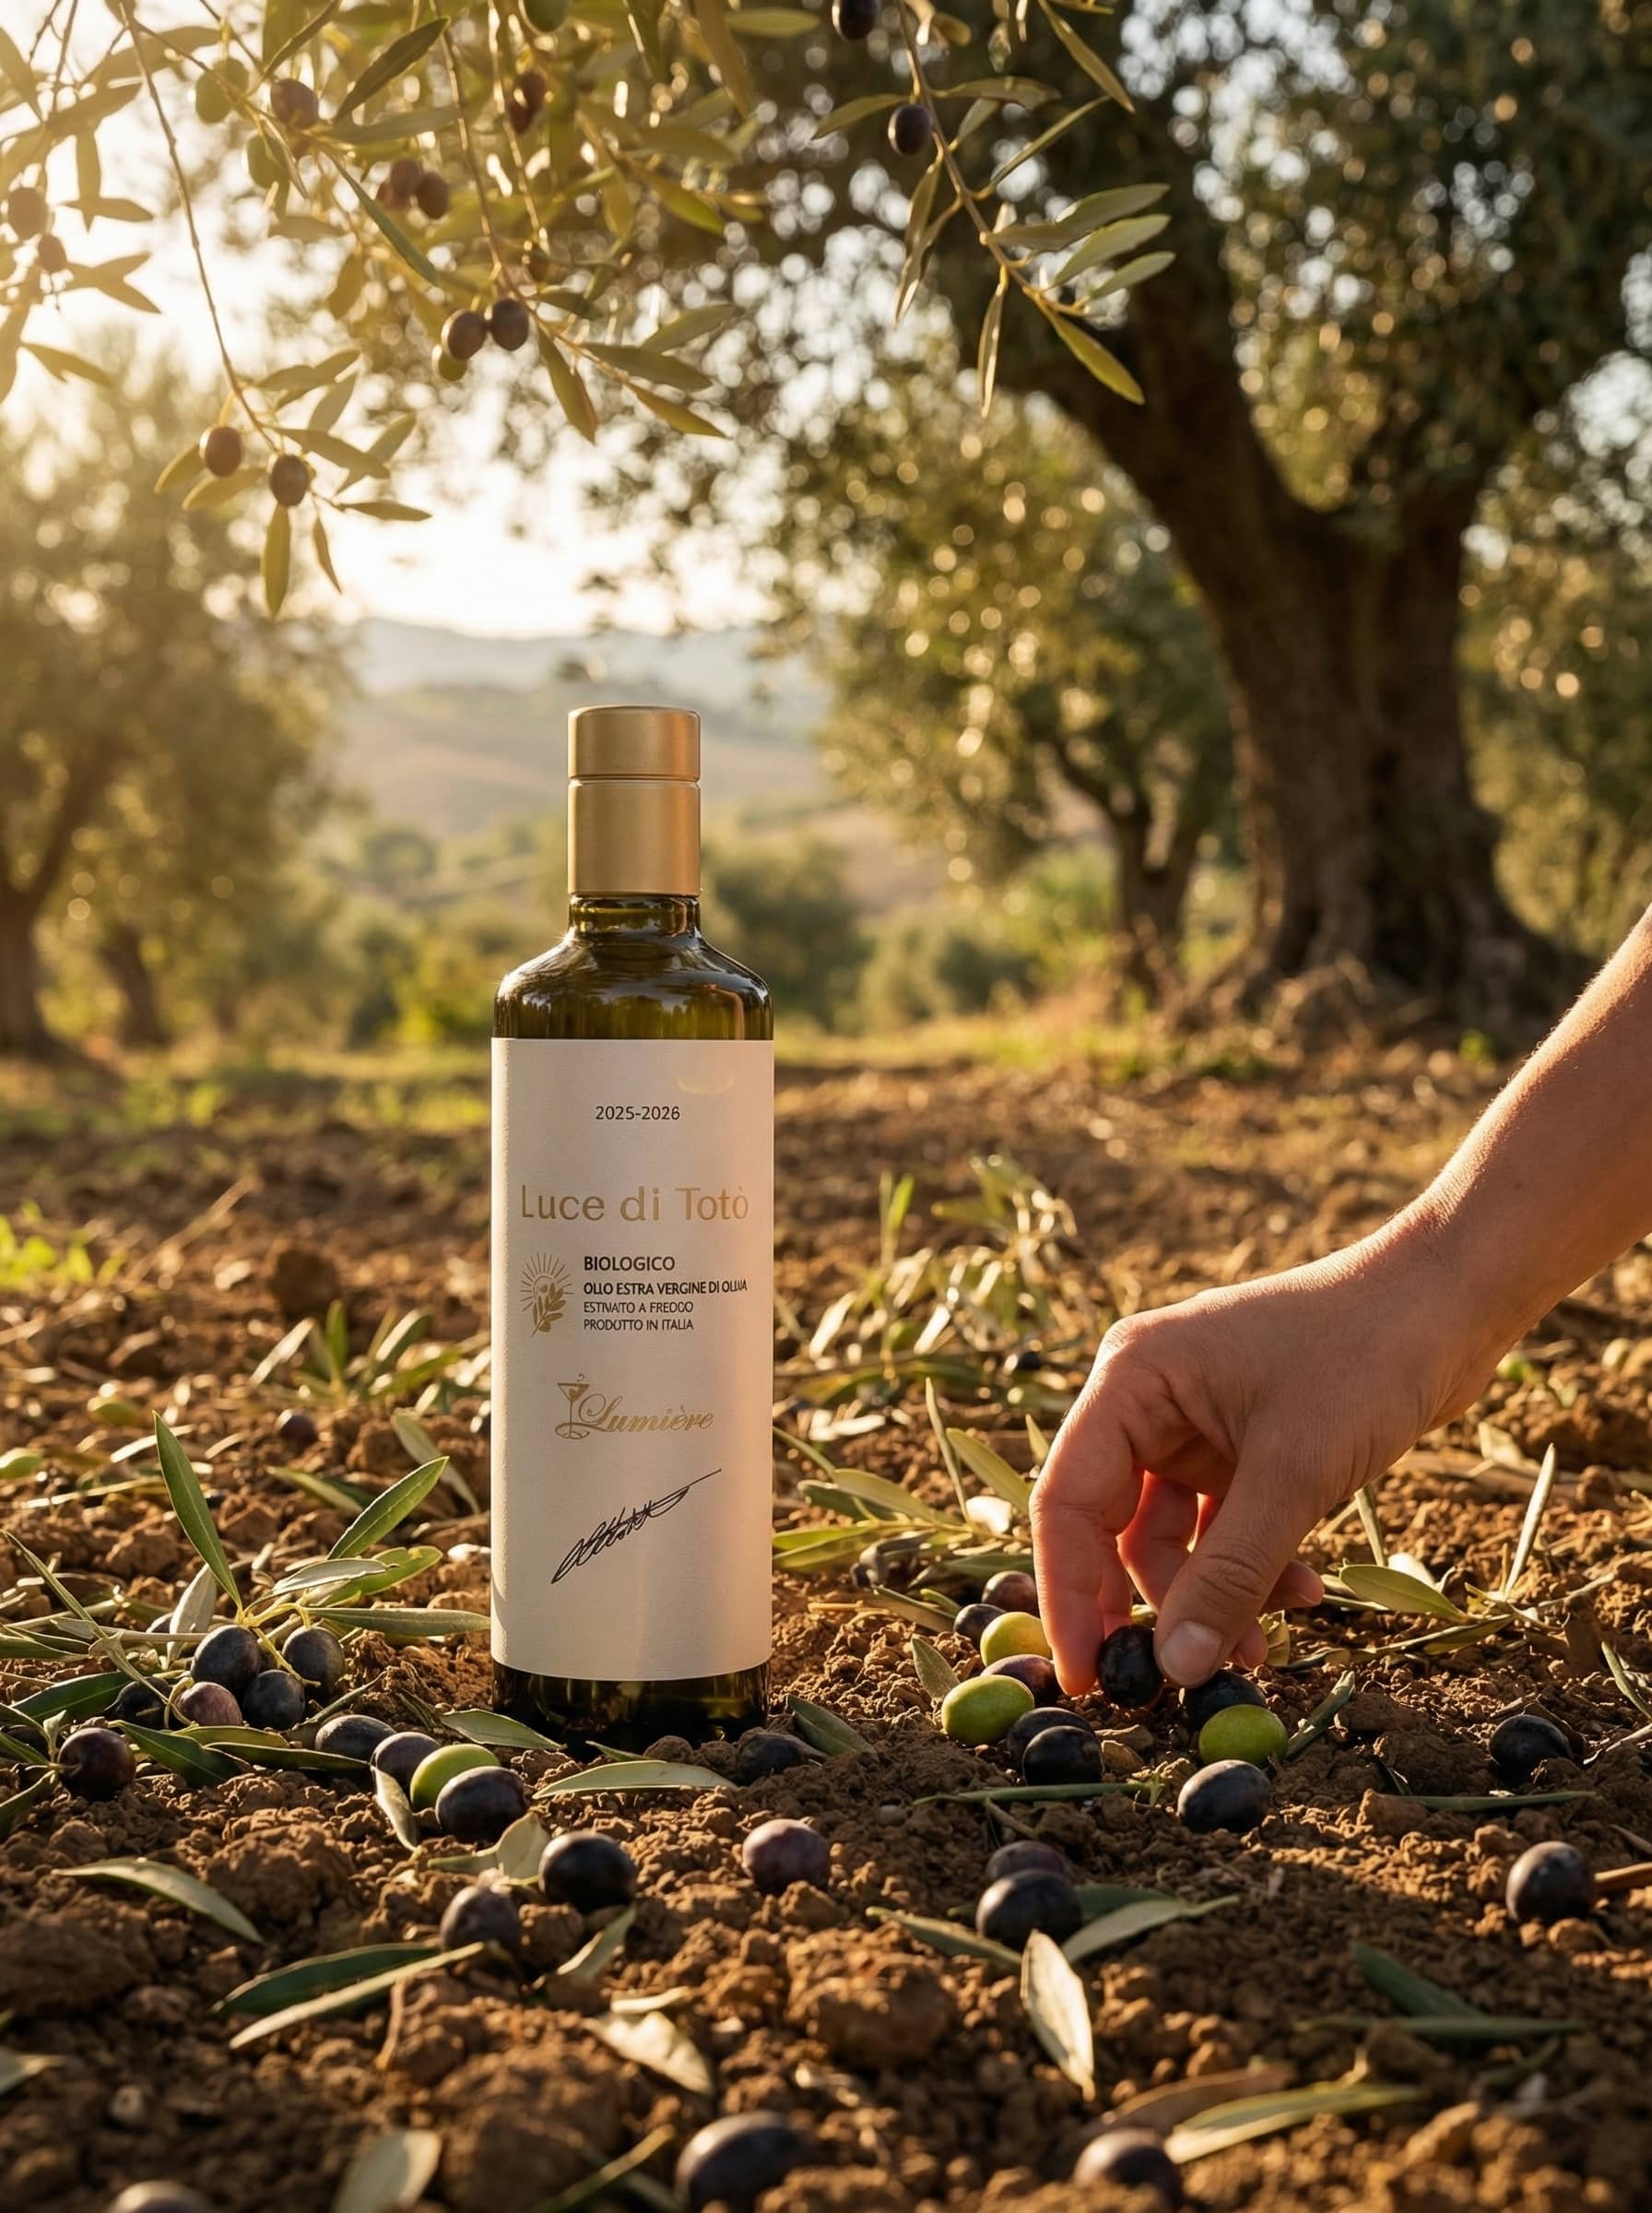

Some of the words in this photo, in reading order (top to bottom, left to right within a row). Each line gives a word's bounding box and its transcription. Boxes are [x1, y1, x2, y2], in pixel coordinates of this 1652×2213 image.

[595, 1106, 680, 1121] 2025-2026
[521, 1184, 605, 1222] Luce
[620, 1186, 660, 1222] di
[675, 1185, 749, 1222] Totò
[584, 1256, 676, 1272] BIOLOGICO
[616, 1283, 655, 1296] ESTRA
[656, 1281, 707, 1296] VERGINE
[708, 1280, 720, 1294] DI
[638, 1302, 646, 1313] A
[646, 1320, 658, 1331] IN
[555, 1392, 714, 1439] Lumière
